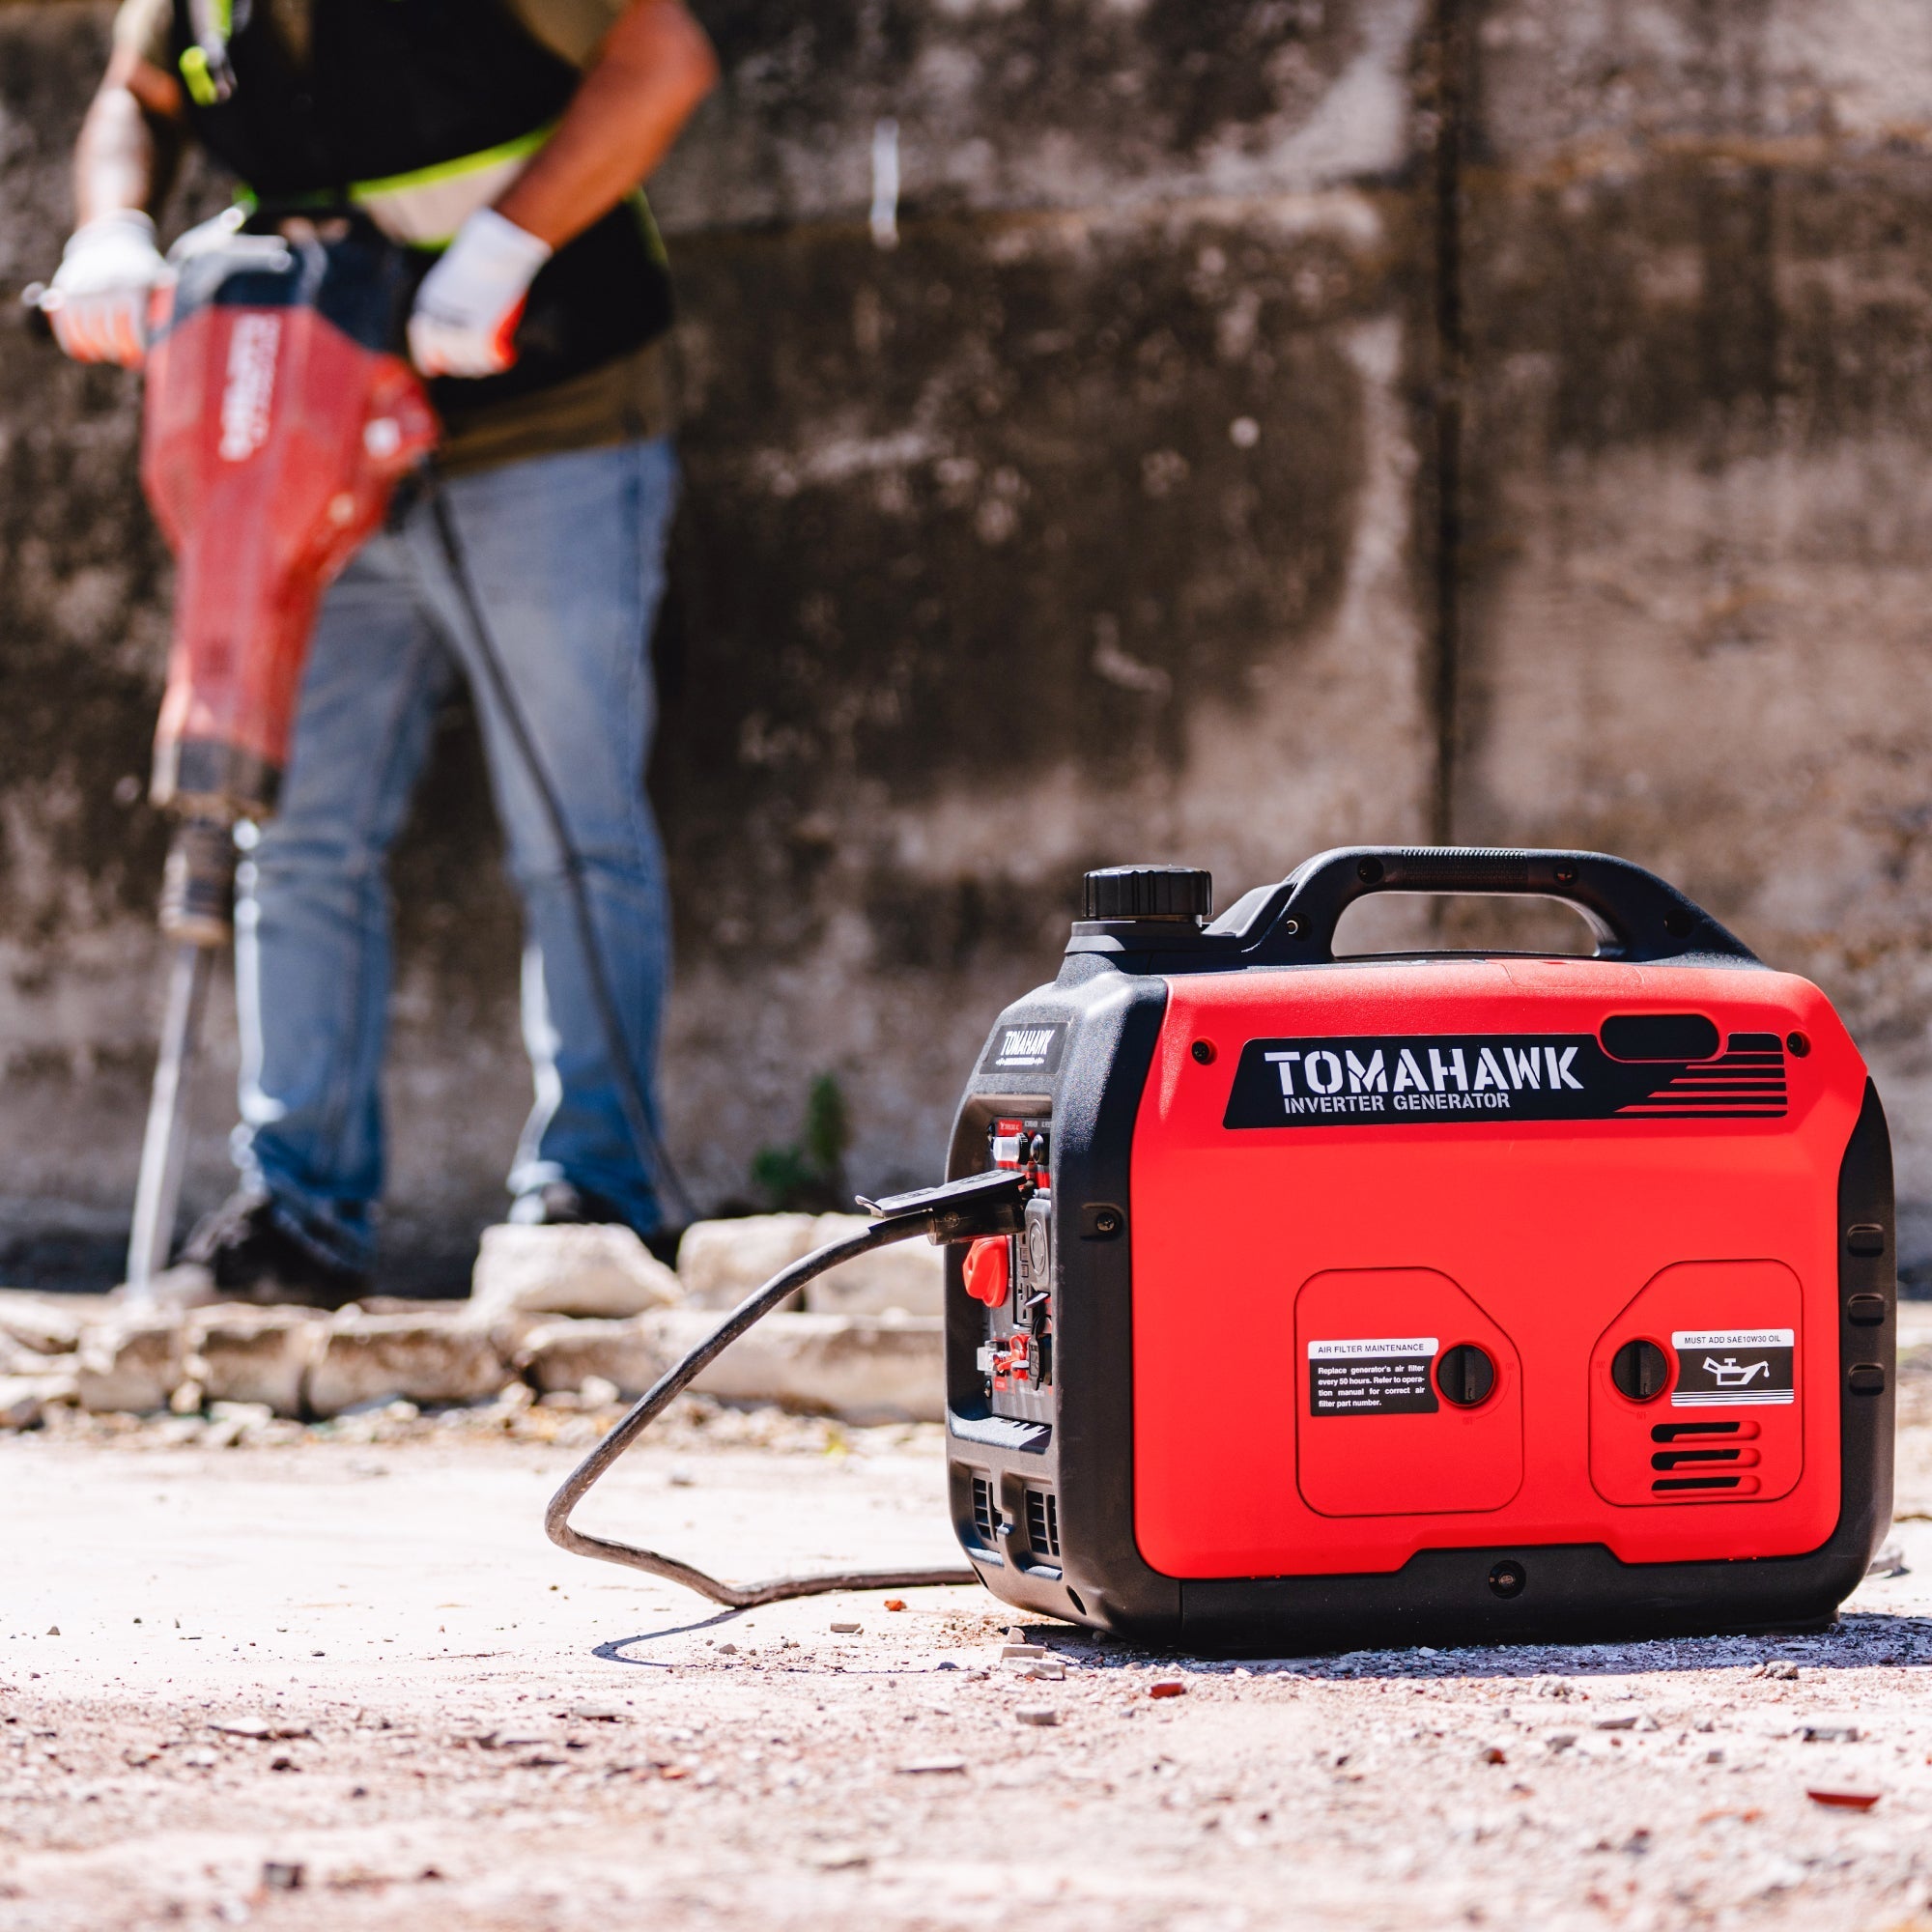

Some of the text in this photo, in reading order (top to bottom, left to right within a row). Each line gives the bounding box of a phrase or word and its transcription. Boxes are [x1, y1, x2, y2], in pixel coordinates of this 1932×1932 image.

[1264, 1047, 1583, 1095] TOMAHAWK
[1283, 1092, 1511, 1114] INVERTER GENERATOR
[1334, 1345, 1362, 1353] FILTER
[1365, 1344, 1424, 1352] MAINTENANCE
[1318, 1367, 1347, 1376] Replace
[1350, 1365, 1391, 1375] generator's
[1402, 1377, 1425, 1385] opera-
[1336, 1400, 1351, 1408] part
